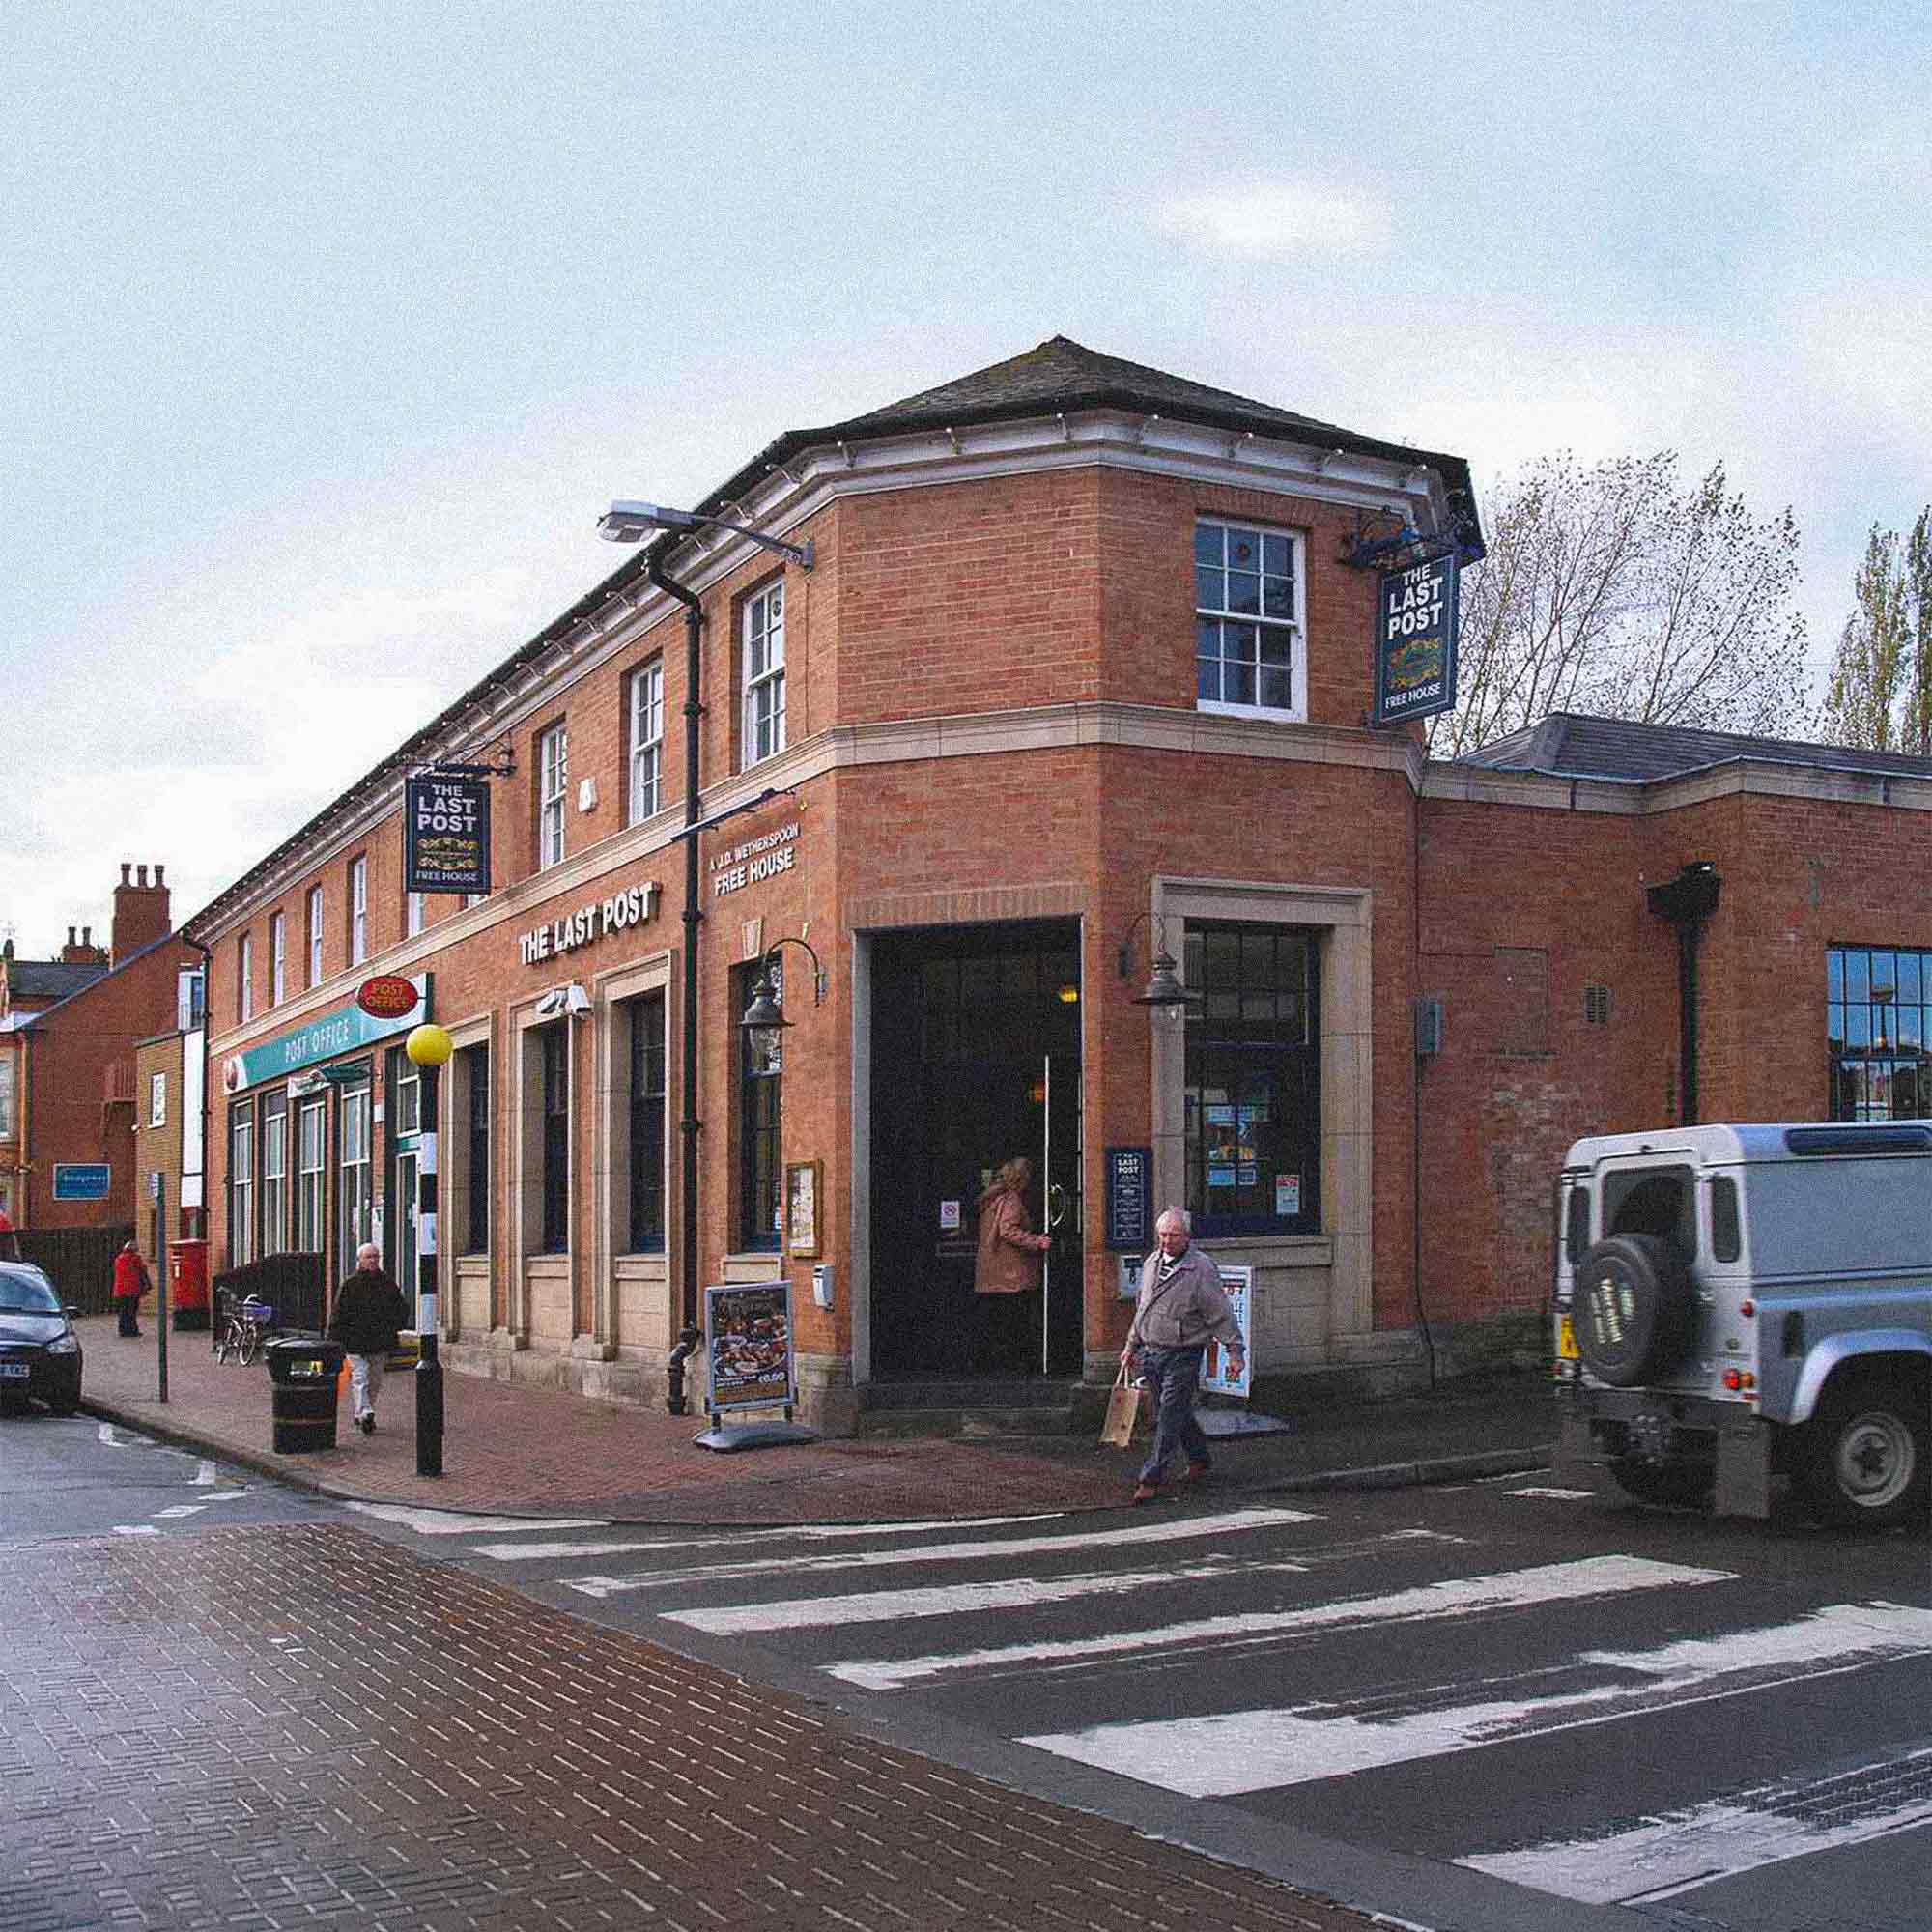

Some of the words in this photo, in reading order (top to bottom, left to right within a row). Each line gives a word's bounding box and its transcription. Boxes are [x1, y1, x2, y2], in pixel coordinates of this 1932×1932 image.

[1403, 563, 1431, 586] THE
[1389, 577, 1443, 614] LAST
[1388, 601, 1443, 639] POST
[1385, 692, 1407, 709] FREE
[1408, 682, 1441, 703] HOUSE
[431, 784, 463, 796] THE
[418, 796, 476, 814] LAST
[417, 814, 477, 832] POST
[734, 822, 801, 862] WETHERSPOON
[416, 870, 440, 880] FREE
[442, 871, 479, 881] HOUSE
[715, 866, 748, 896] FREE
[750, 846, 794, 882] HOUSE
[519, 924, 550, 965] THE
[554, 904, 598, 952] LAST
[603, 881, 658, 934] POST
[364, 996, 410, 1008] OFFICE
[372, 983, 404, 996] POST
[285, 1036, 308, 1063] POST
[312, 1020, 349, 1052] OFFICE
